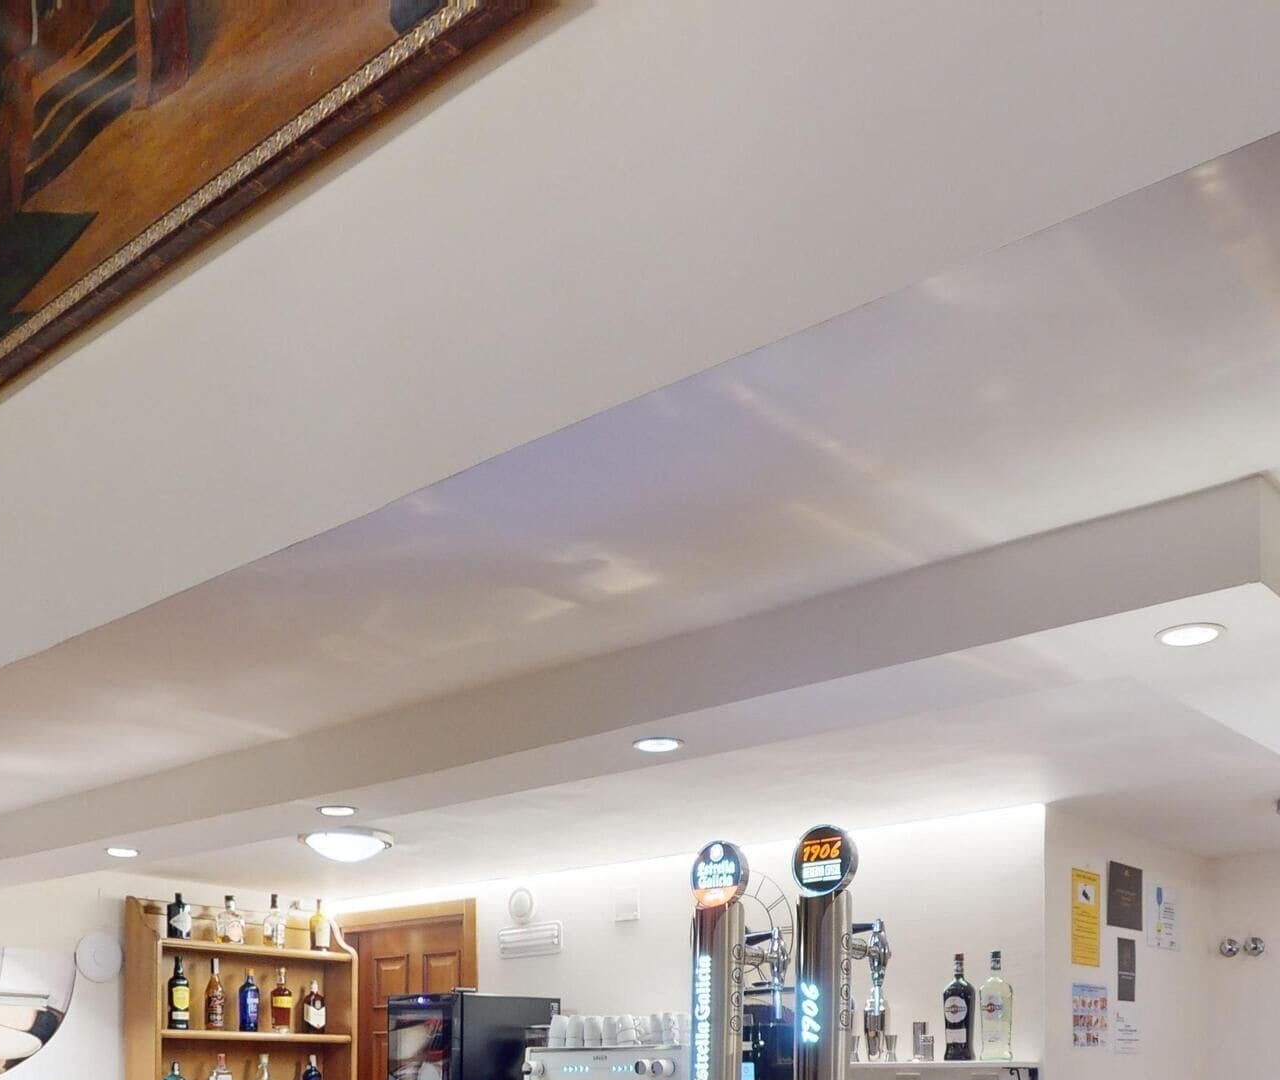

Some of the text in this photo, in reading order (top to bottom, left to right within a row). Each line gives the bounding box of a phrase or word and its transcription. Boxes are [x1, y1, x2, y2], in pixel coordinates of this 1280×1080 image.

[803, 840, 842, 862] 1906
[697, 860, 735, 877] Estrella
[698, 874, 733, 889] Galicia
[694, 954, 712, 1021] Galicia
[801, 982, 821, 1044] 1906
